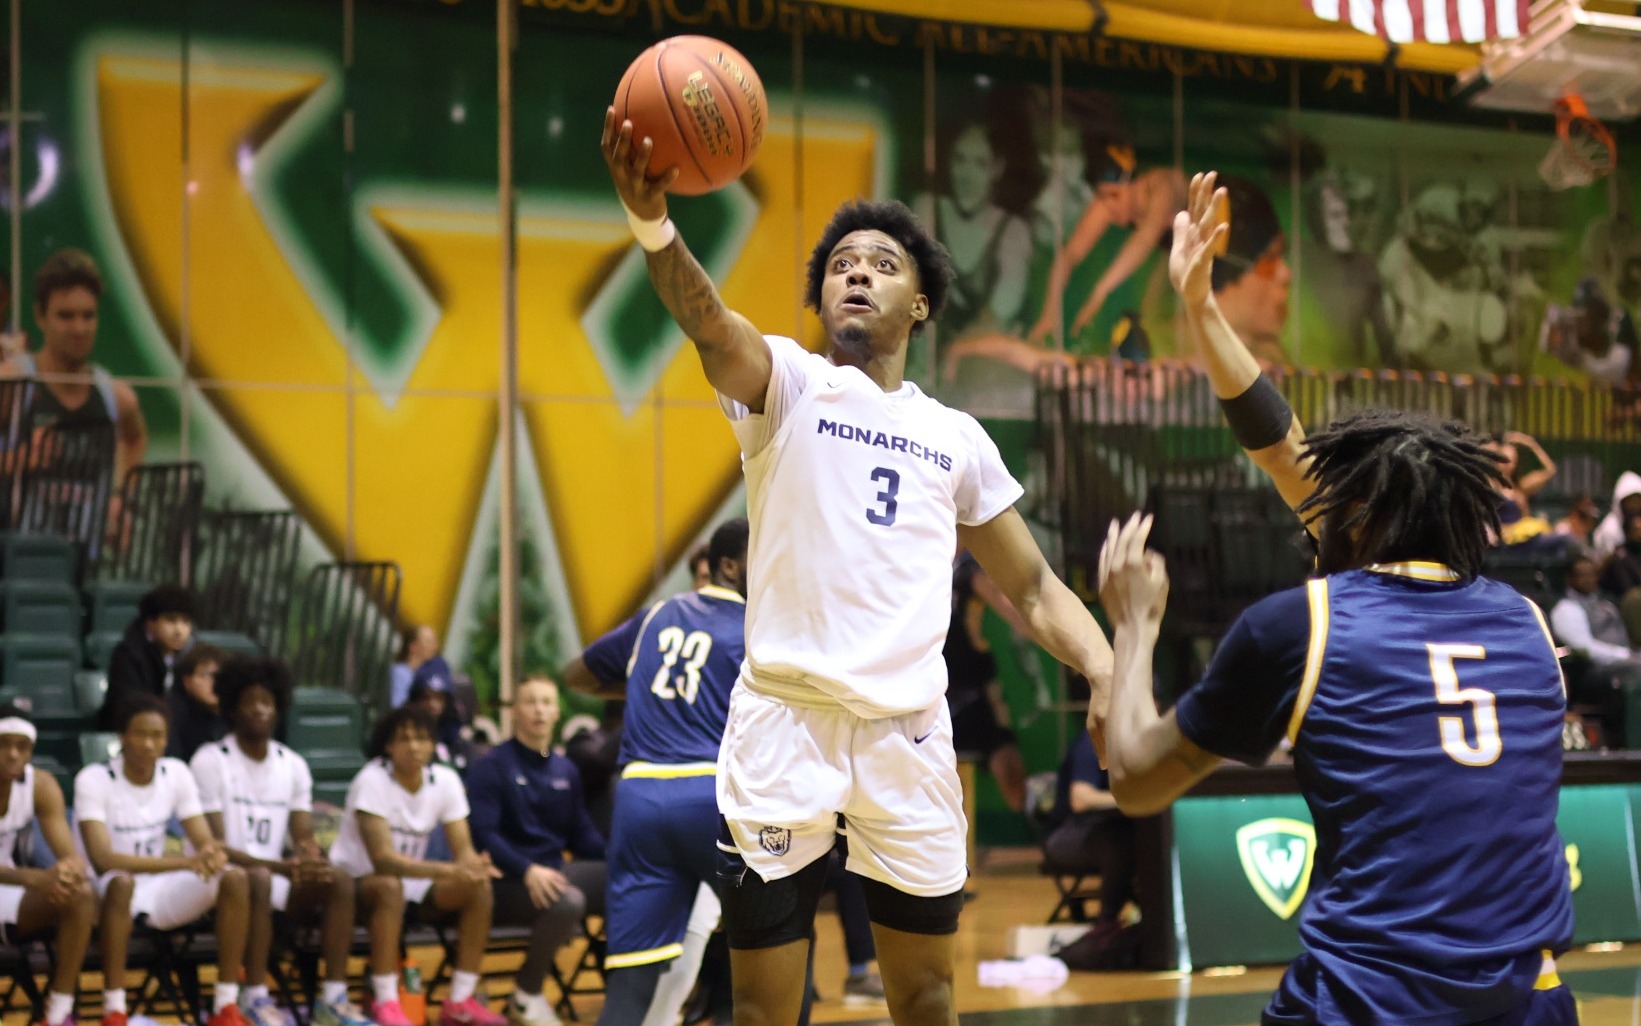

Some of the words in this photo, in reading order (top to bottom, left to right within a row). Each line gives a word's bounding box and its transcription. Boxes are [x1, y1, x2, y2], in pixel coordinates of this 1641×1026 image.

[816, 418, 953, 472] MONARCHS
[865, 466, 901, 527] 3
[650, 626, 713, 705] 23
[1425, 643, 1502, 767] 5
